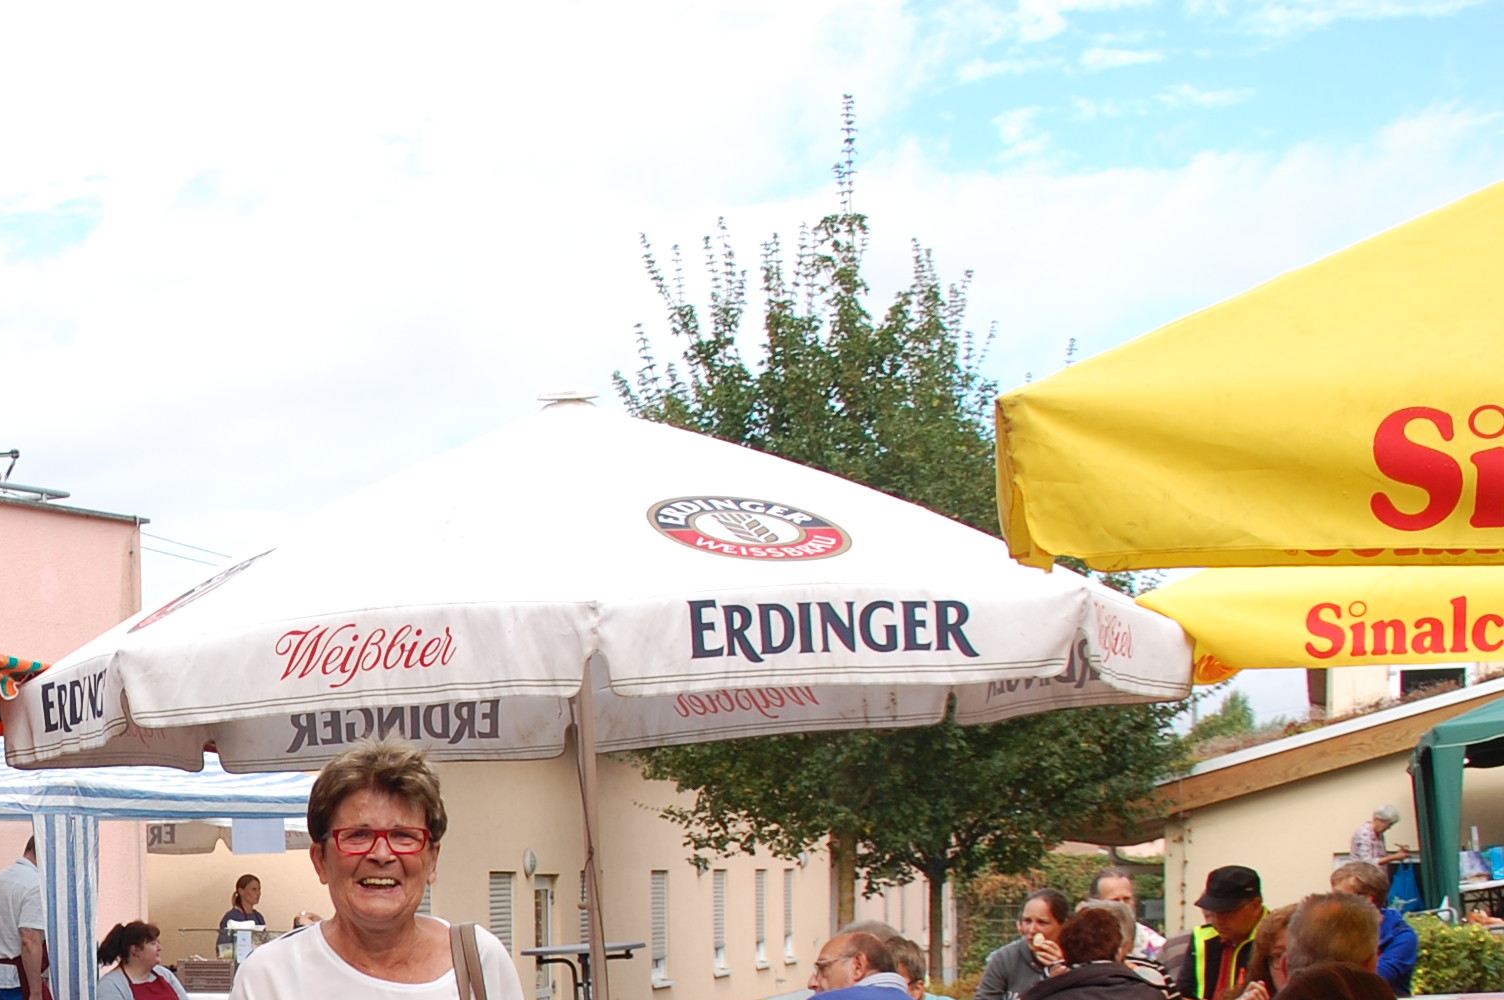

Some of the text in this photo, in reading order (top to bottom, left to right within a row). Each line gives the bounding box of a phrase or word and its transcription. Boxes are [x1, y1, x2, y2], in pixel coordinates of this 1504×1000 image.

[657, 498, 814, 526] ERDINGER
[275, 623, 457, 688] Weißbier
[686, 598, 981, 663] ERDINGER
